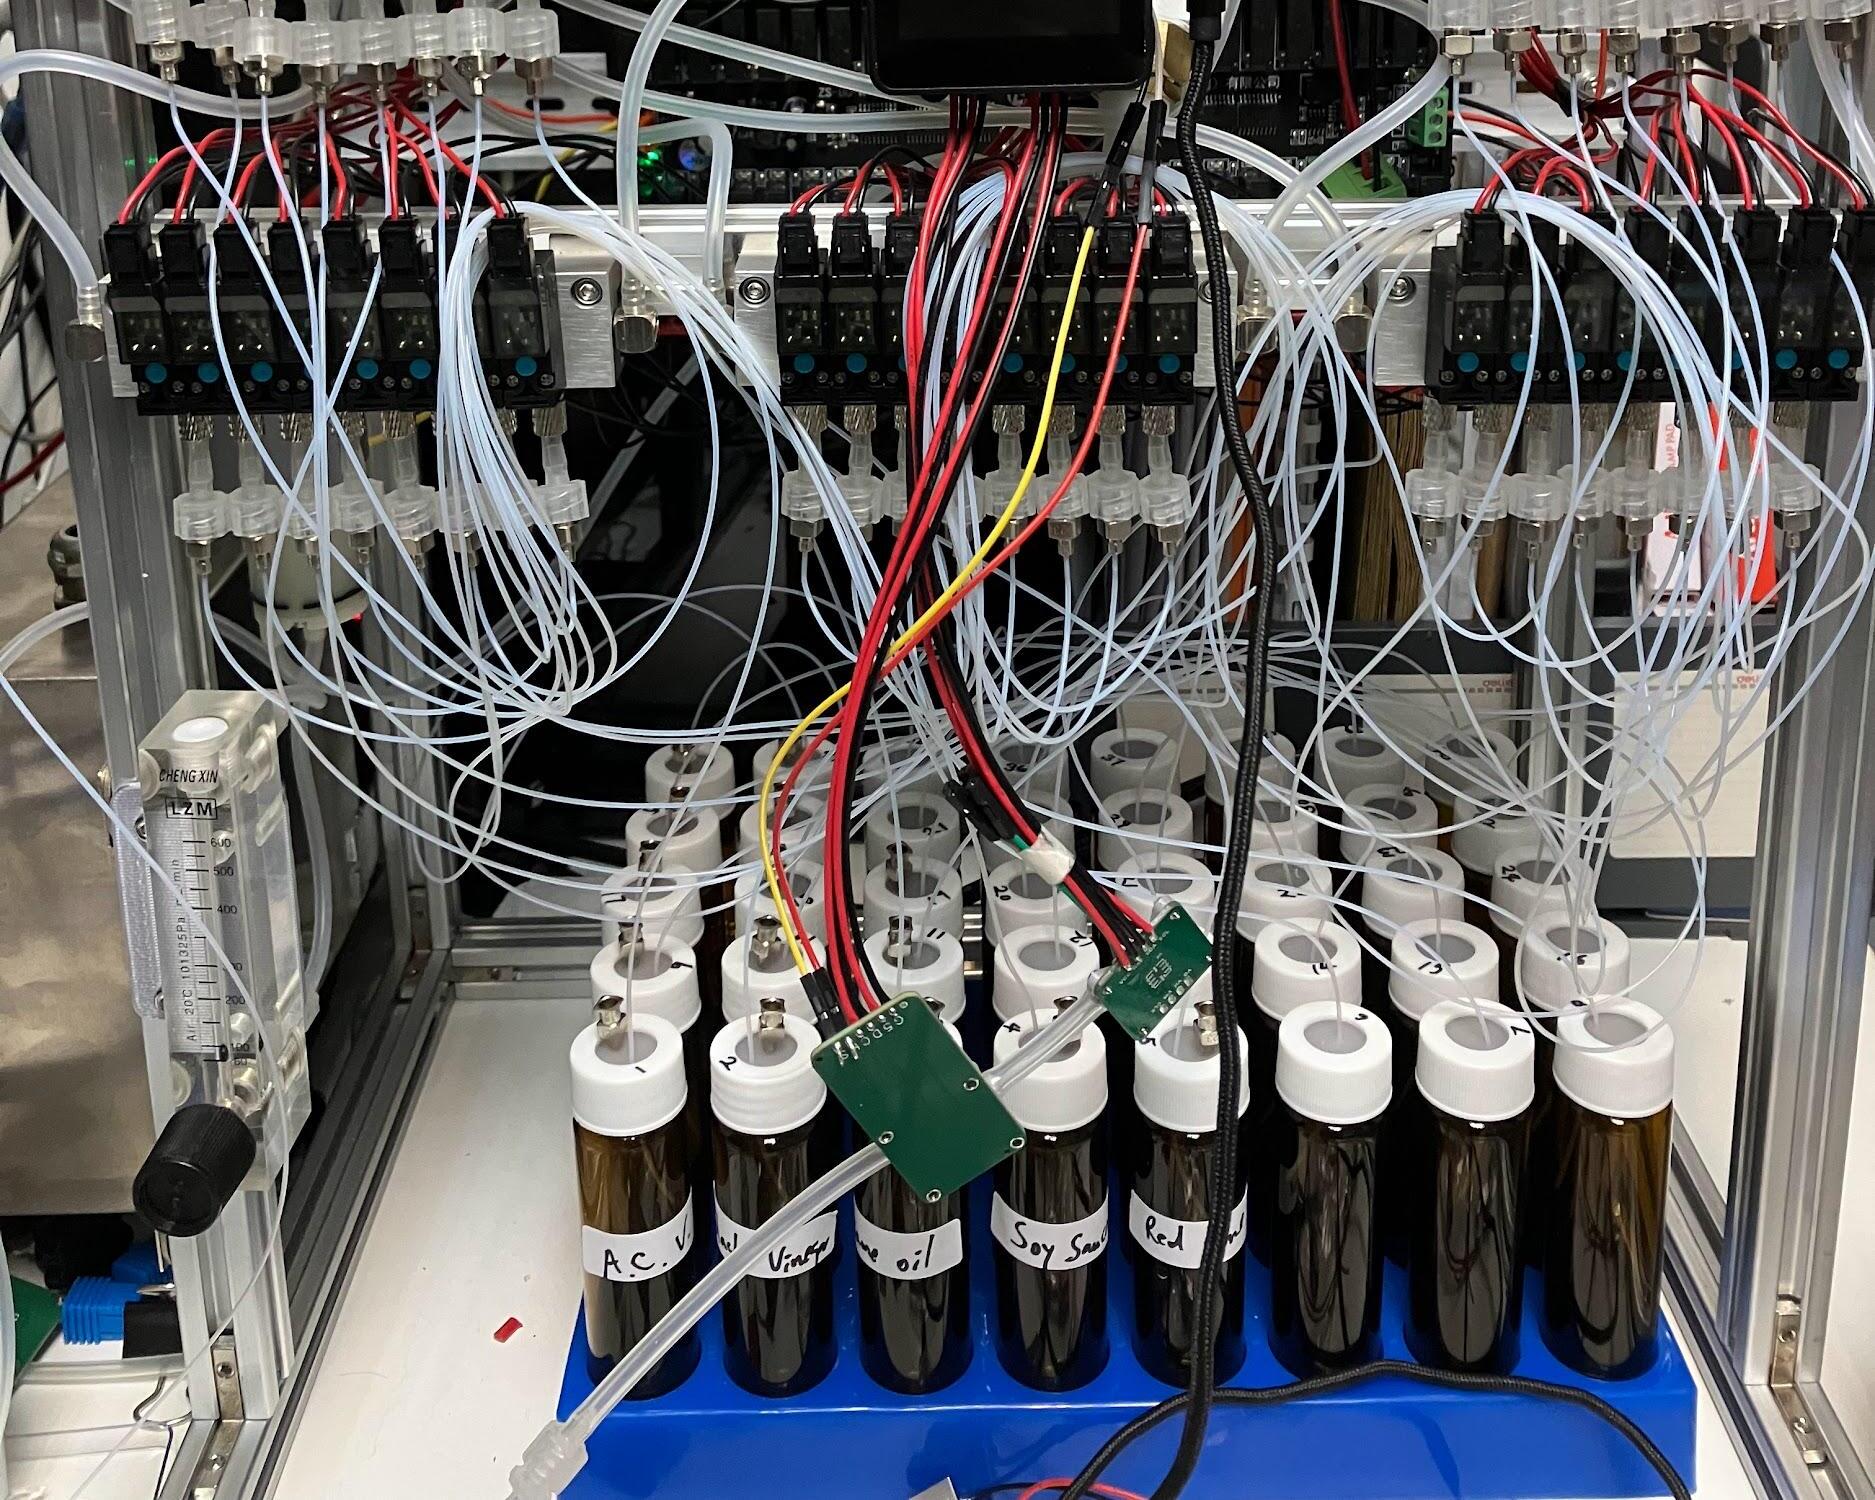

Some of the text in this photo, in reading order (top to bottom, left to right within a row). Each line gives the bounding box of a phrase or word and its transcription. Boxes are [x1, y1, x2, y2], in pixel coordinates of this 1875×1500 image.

[159, 769, 219, 784] CHENG XIN
[171, 802, 213, 816] LZM
[213, 866, 234, 877] 500
[1501, 864, 1522, 883] 24
[993, 885, 1012, 901] 20
[216, 903, 238, 915] 400
[1069, 930, 1093, 948] 12
[176, 917, 191, 980] 101325Pa
[225, 995, 246, 1005] 200
[186, 1025, 198, 1042] Air
[1002, 1022, 1021, 1033] 4
[1510, 1025, 1531, 1036] 7
[719, 1056, 737, 1072] 2
[1145, 1215, 1184, 1251] Red
[896, 1233, 935, 1272] oil
[1010, 1221, 1055, 1271] Soy
